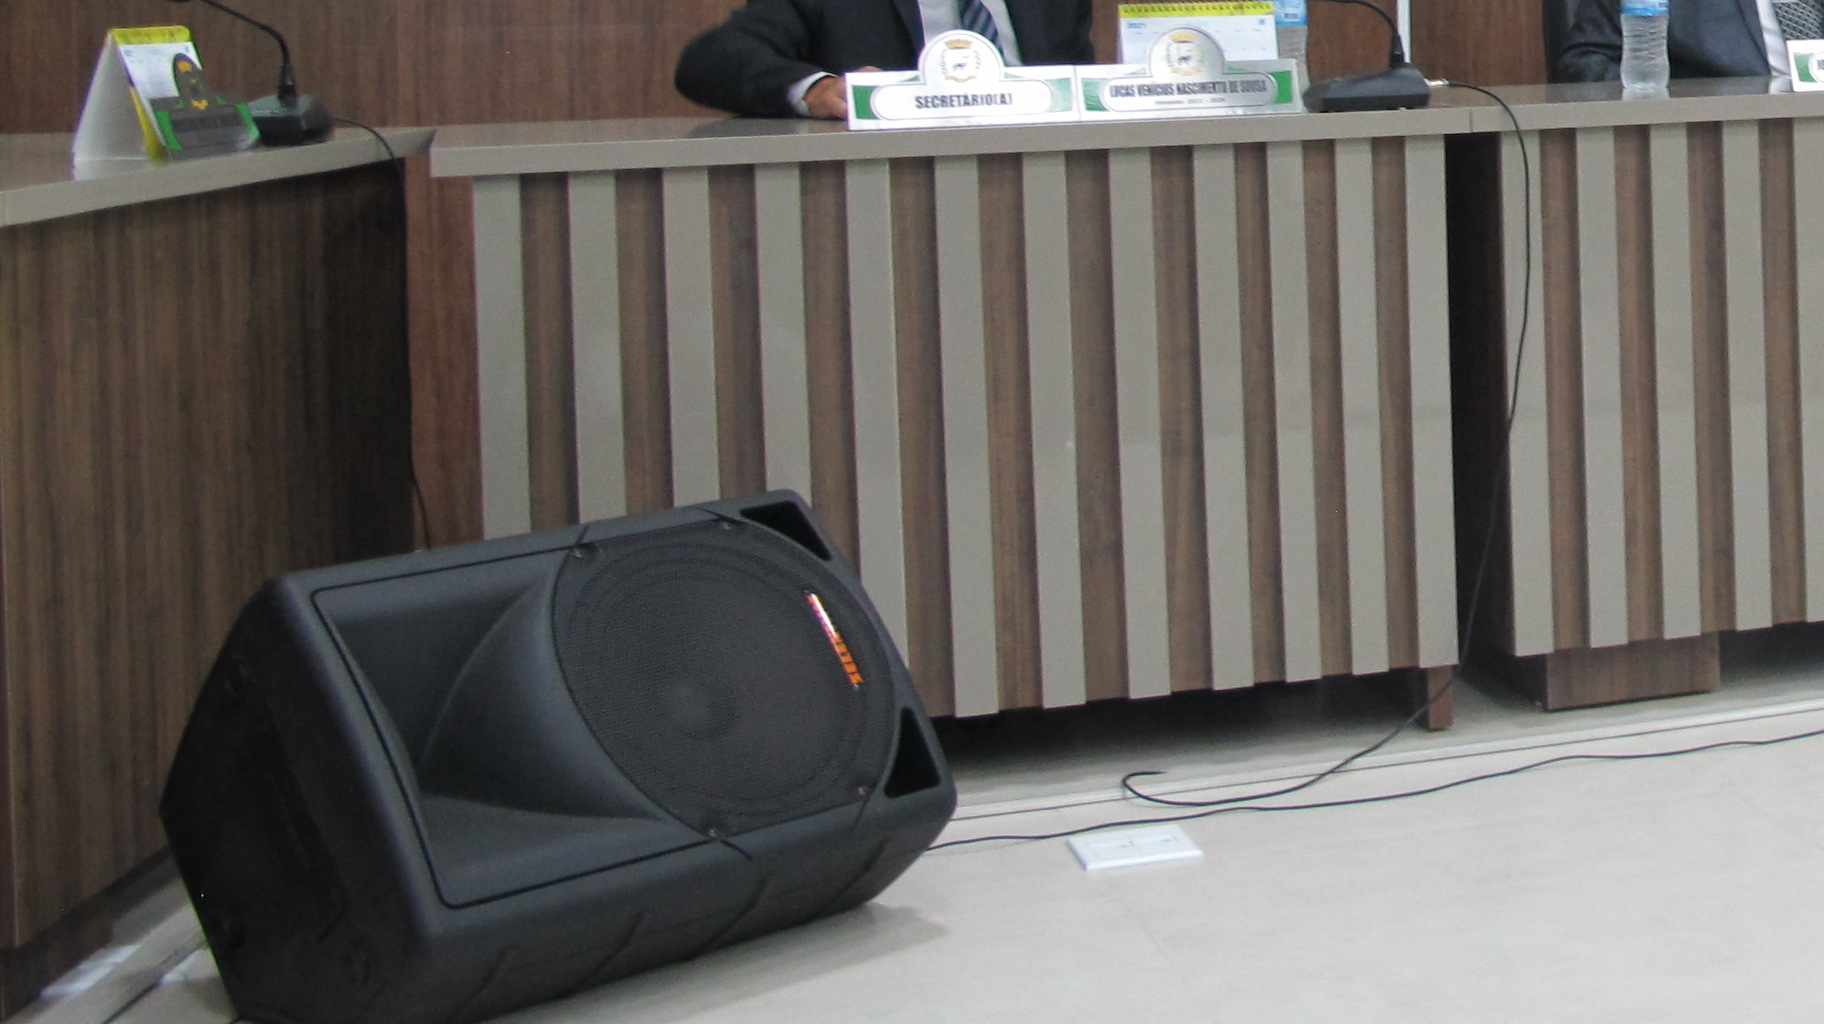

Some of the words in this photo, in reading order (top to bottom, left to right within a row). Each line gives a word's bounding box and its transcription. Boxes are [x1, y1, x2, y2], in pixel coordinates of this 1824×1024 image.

[1109, 84, 1136, 98] LUCAS
[1176, 80, 1227, 95] NASCIMENTO
[1228, 80, 1240, 93] DE
[914, 92, 1013, 109] SECRETÁRIO(A)
